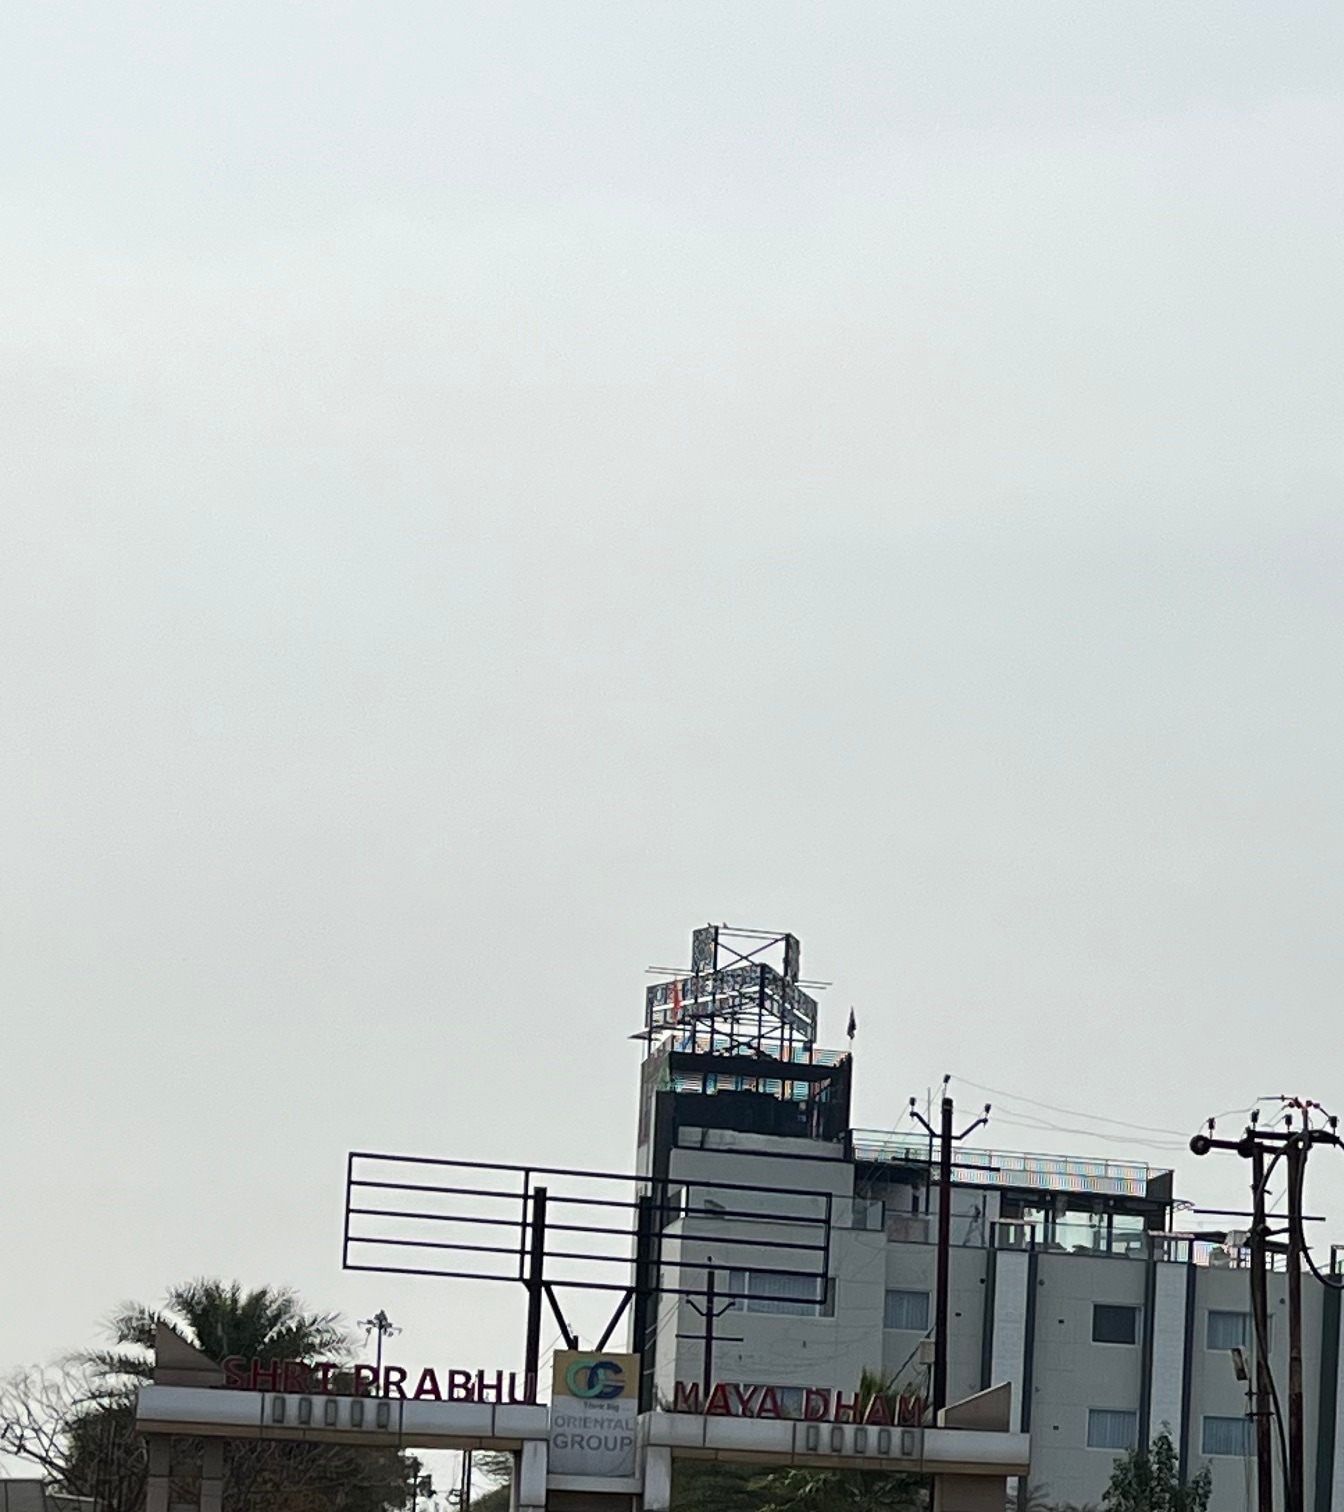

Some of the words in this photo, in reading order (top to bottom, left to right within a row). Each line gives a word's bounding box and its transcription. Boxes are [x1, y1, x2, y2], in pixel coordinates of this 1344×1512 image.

[353, 1363, 539, 1405] PRABHU
[673, 1380, 783, 1419] MAYA
[802, 1387, 923, 1428] DHAM
[553, 1415, 635, 1432] ORIENTAL
[552, 1432, 633, 1453] GROUP
